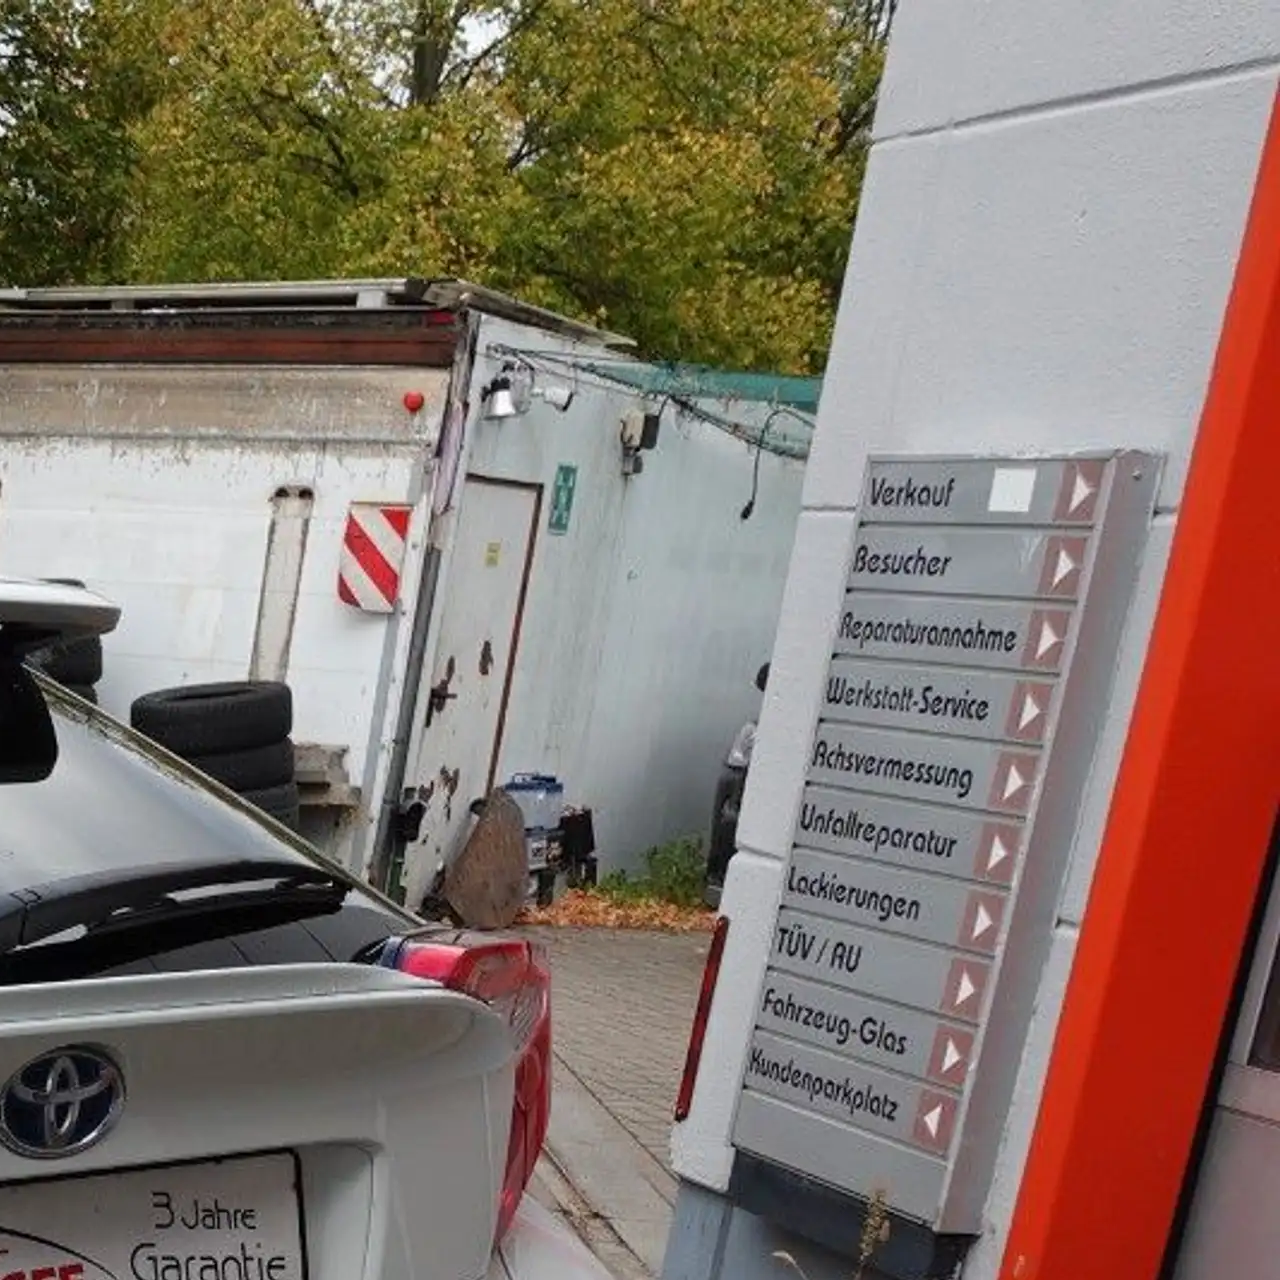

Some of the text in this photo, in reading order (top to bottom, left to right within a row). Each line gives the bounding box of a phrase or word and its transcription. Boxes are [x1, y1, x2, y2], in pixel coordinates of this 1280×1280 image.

[871, 477, 955, 507] Verkauf
[853, 545, 952, 577] Besucher
[841, 611, 1017, 653] Reparaturannahme
[826, 677, 990, 720] Werkstatt-Service
[812, 741, 975, 798] Achsvermessung
[800, 804, 958, 858] Unfallreparatur
[787, 867, 921, 922] Lackierungen
[778, 924, 814, 963] TÜV
[831, 941, 863, 973] AU
[762, 988, 908, 1056] Fahrzeug-Glas
[749, 1047, 900, 1122] Kundenparkplatz
[151, 1191, 257, 1231] 3 Jahre
